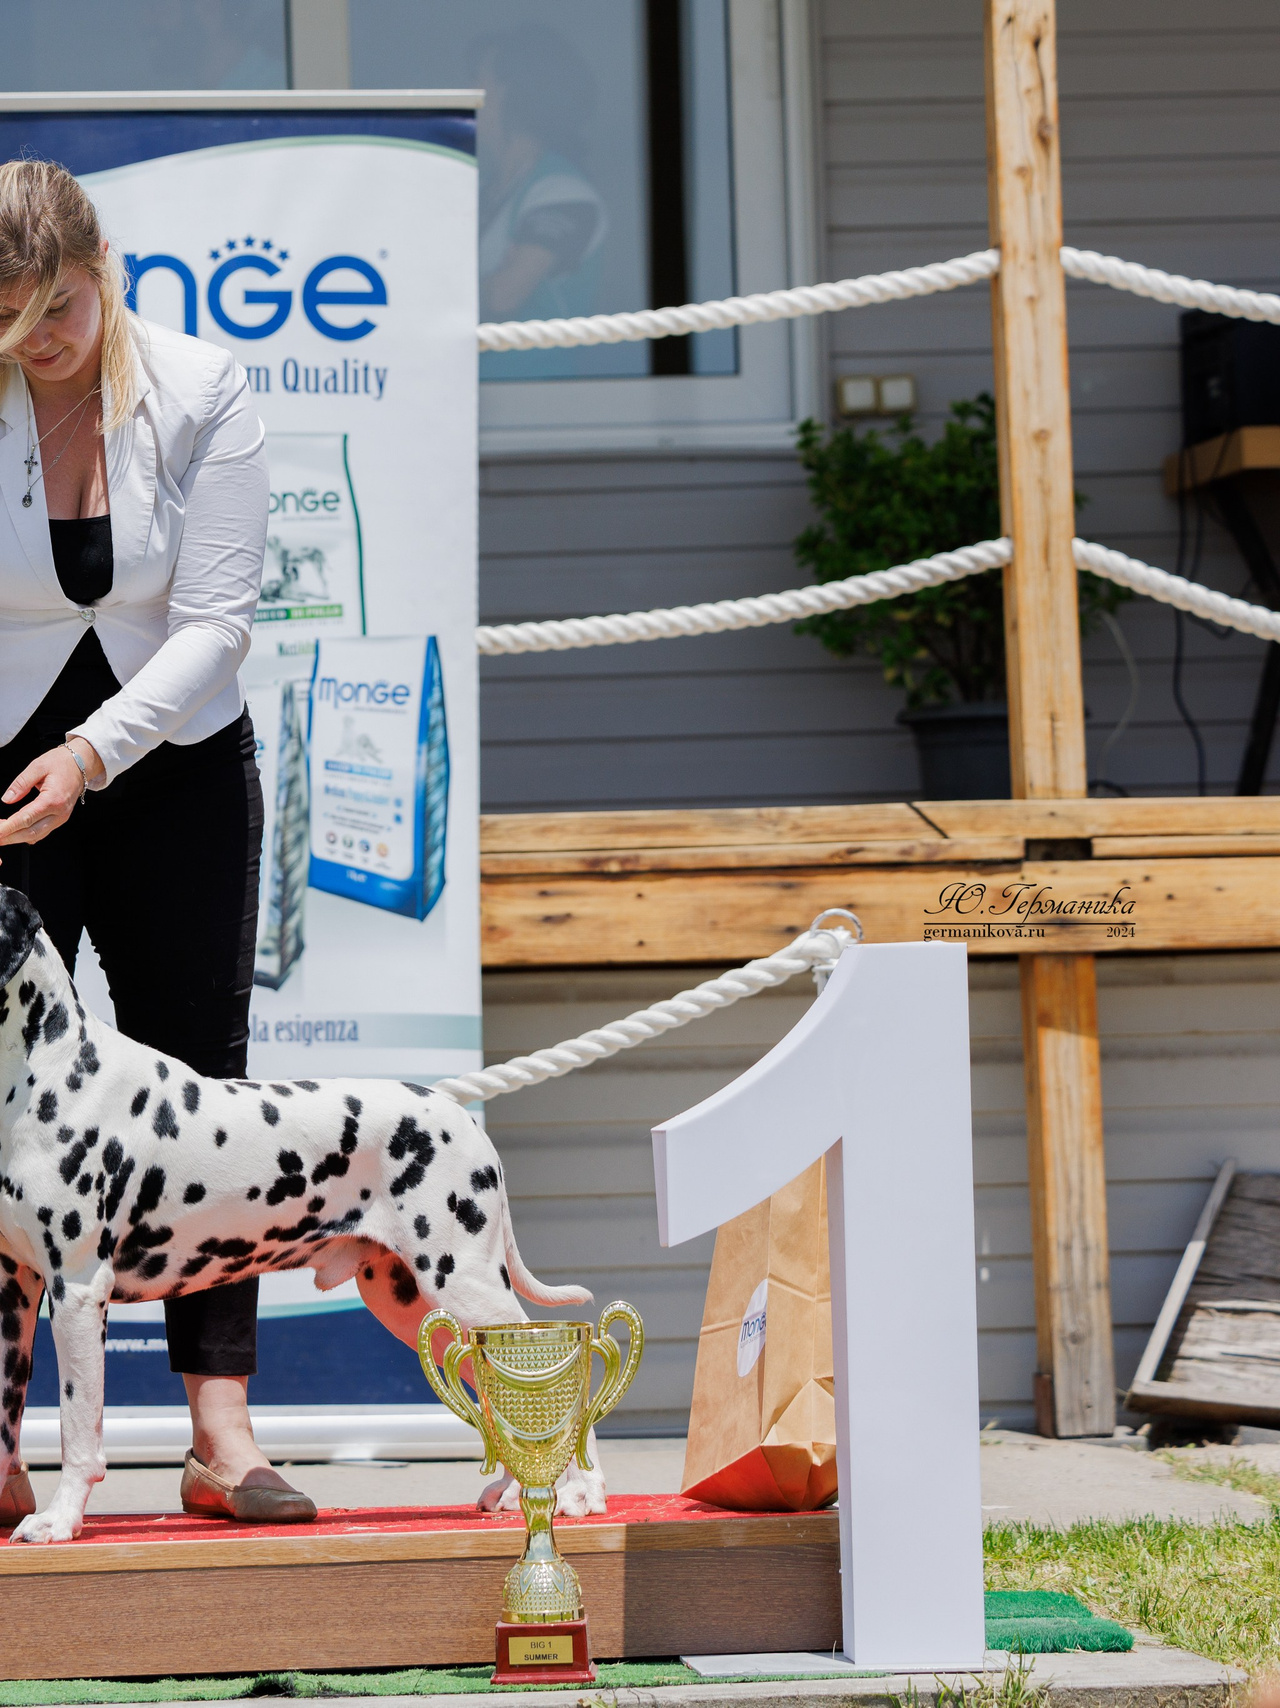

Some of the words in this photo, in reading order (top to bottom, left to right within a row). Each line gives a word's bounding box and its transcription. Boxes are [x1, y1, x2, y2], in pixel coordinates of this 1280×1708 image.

[282, 357, 387, 401] Quality
[251, 1013, 269, 1042] la
[274, 1013, 359, 1047] esigenza
[530, 1641, 546, 1649] BIG
[524, 1653, 558, 1661] SUMMER
